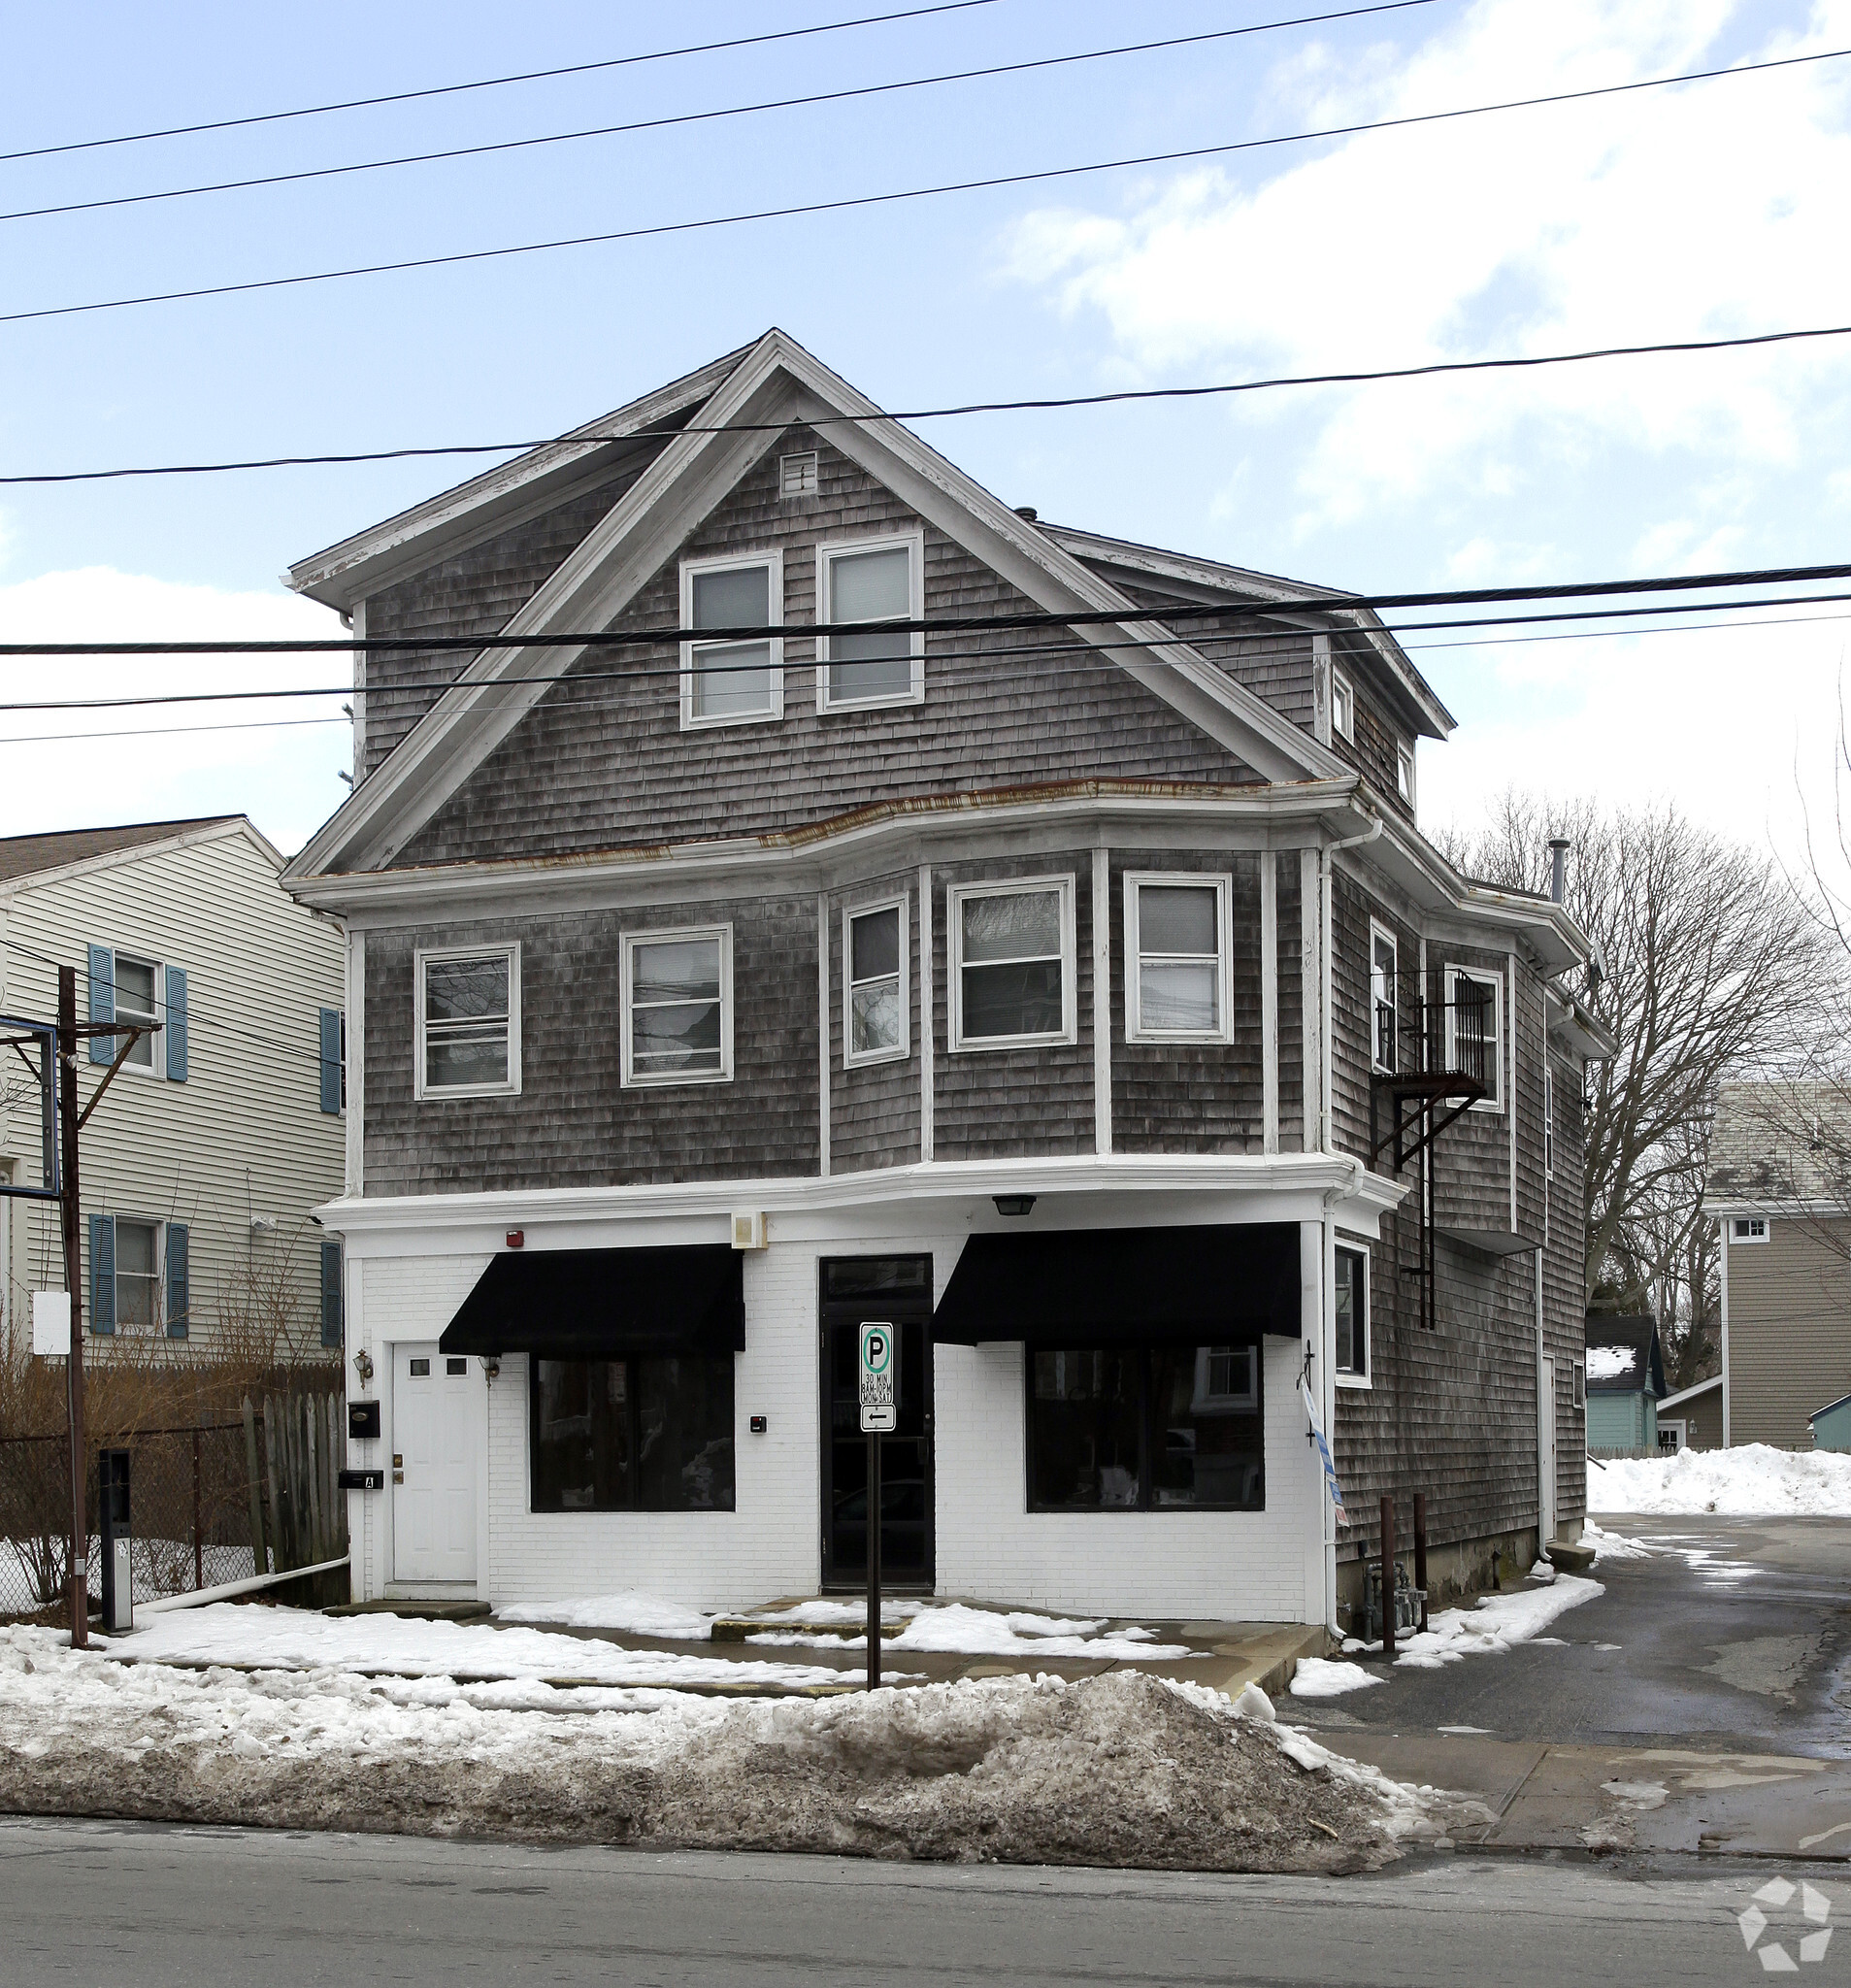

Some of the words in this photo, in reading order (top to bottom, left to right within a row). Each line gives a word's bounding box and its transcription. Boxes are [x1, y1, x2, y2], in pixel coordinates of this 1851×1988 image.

[870, 1336, 883, 1366] P
[866, 1374, 874, 1383] 30
[876, 1374, 888, 1383] MIN
[366, 1477, 373, 1488] A
